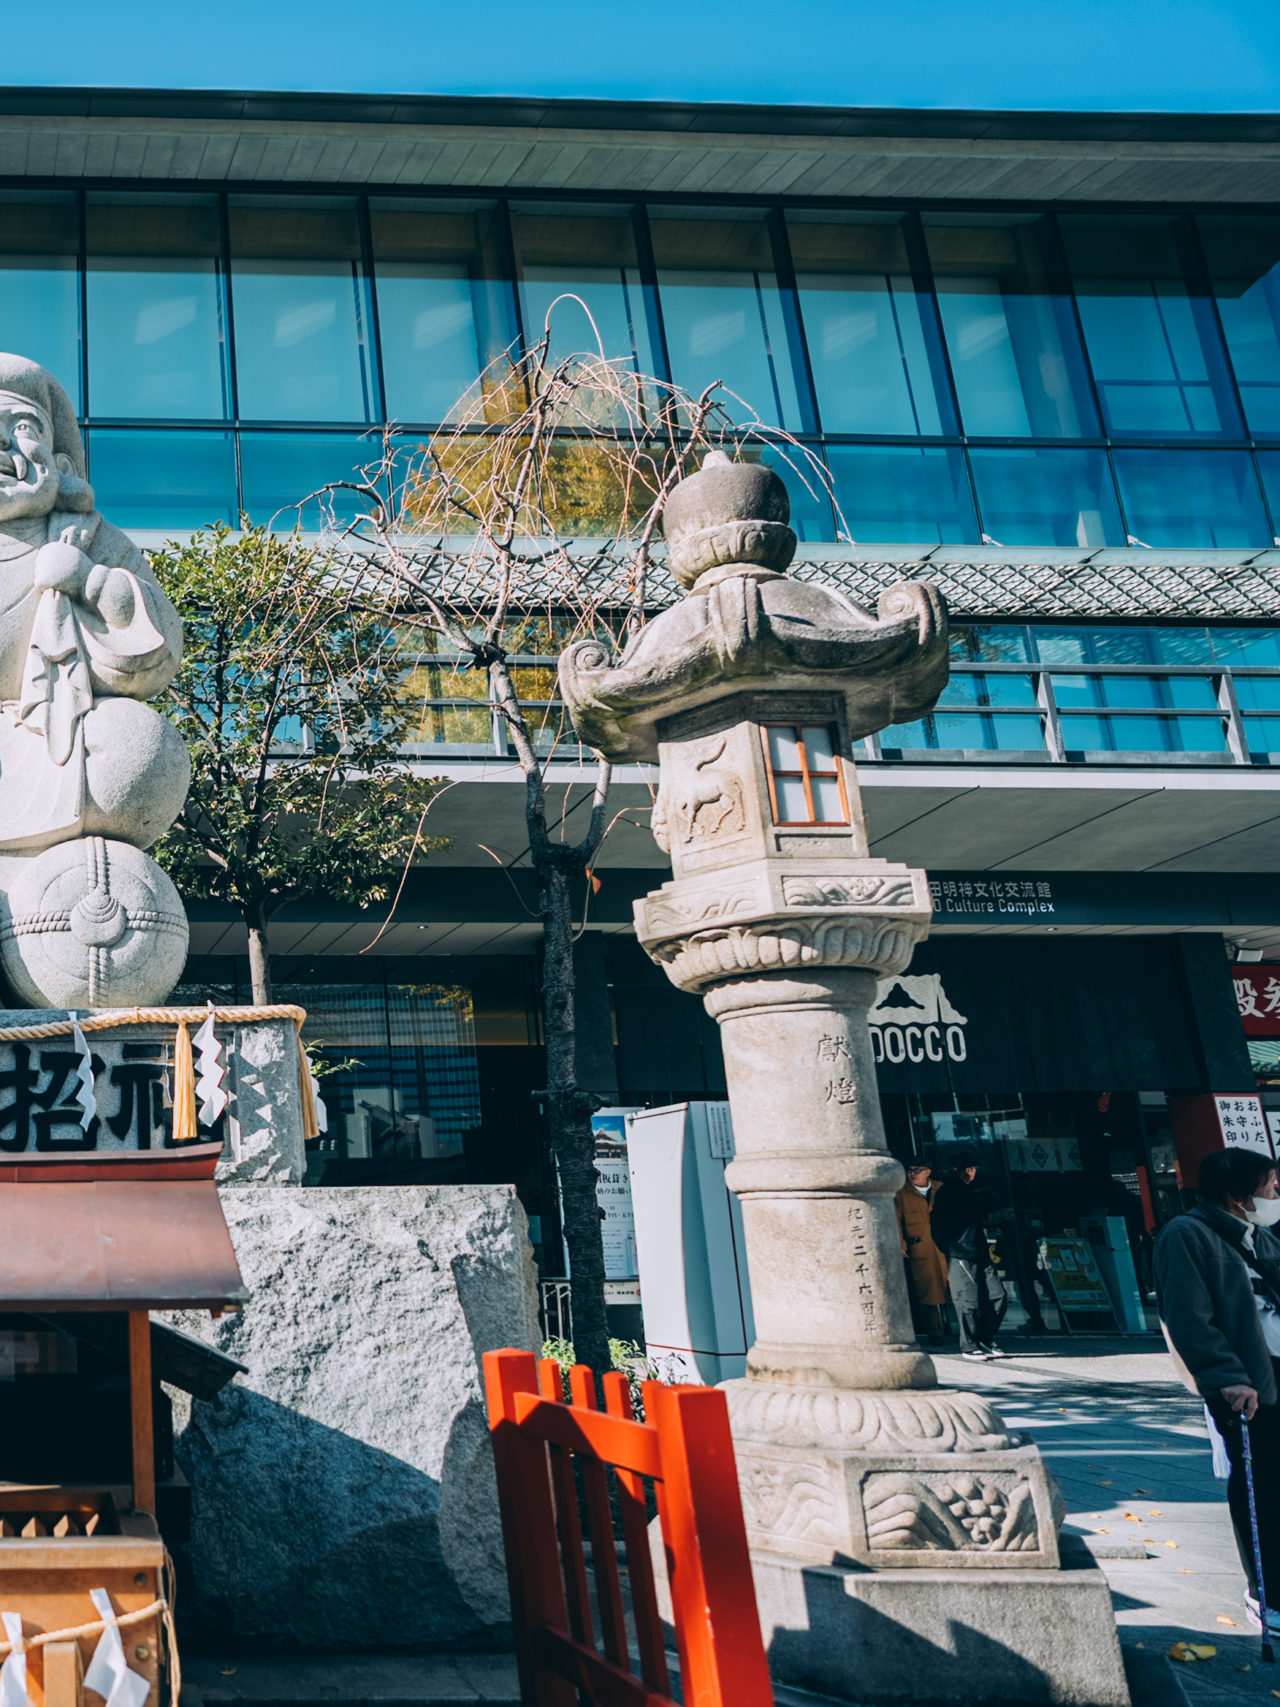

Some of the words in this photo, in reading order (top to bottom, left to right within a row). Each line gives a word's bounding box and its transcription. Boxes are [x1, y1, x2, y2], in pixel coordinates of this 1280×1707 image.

[947, 898, 994, 912] Culture
[999, 898, 1055, 916] Complex
[1219, 1100, 1238, 1143] 御朱印
[1233, 1100, 1251, 1143] お守り
[1247, 1100, 1266, 1143] おふだ
